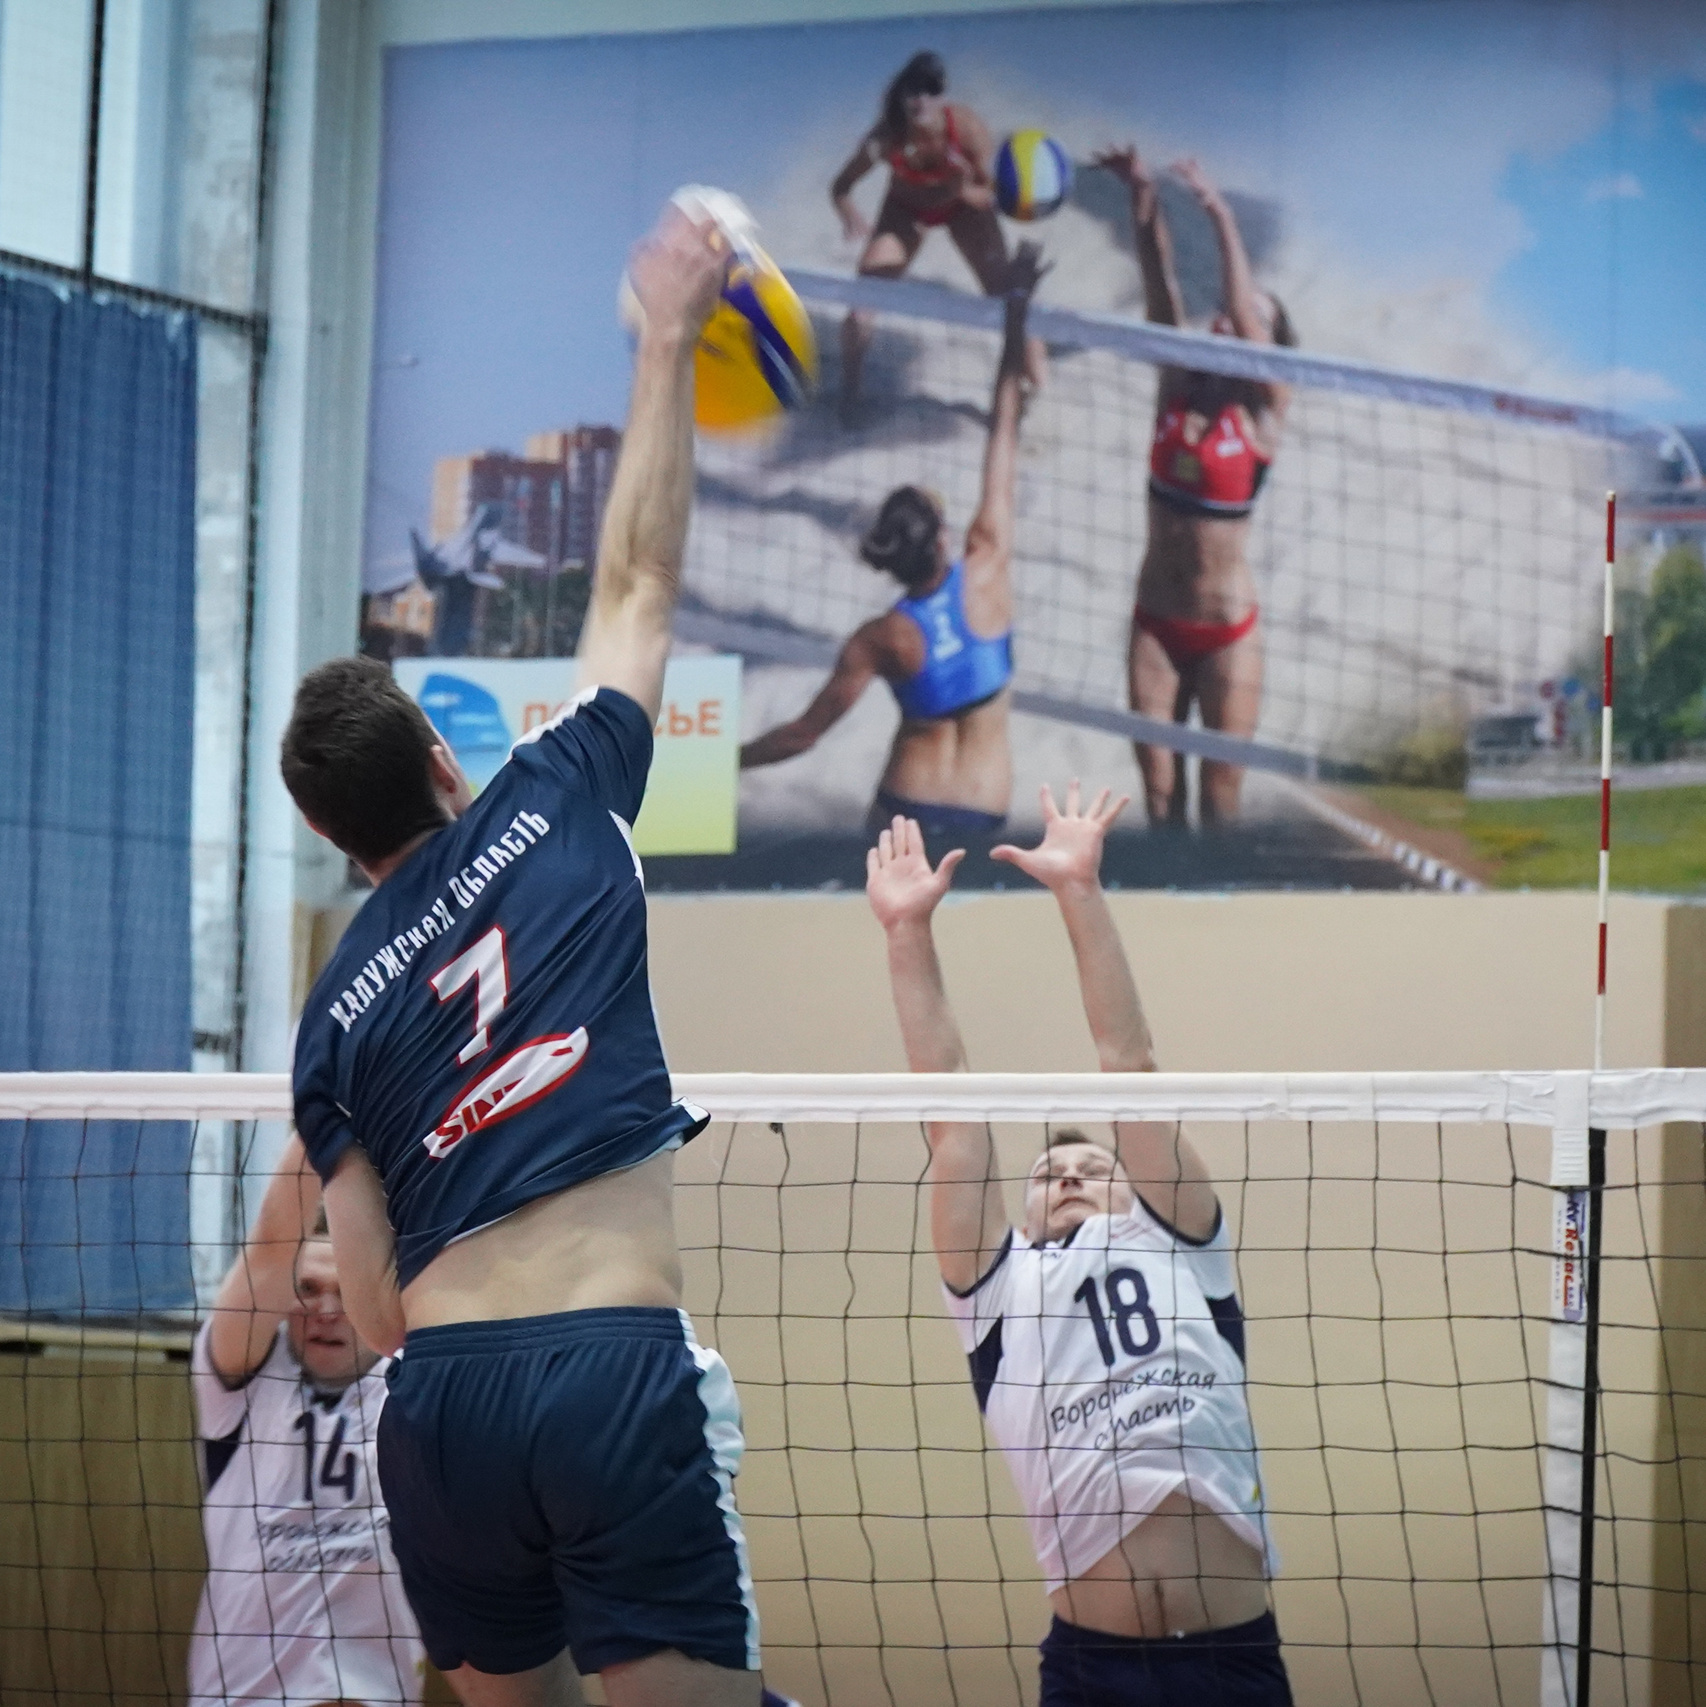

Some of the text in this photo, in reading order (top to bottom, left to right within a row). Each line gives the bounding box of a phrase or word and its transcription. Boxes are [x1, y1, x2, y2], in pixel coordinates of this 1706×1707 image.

[449, 810, 550, 909] ОБЛАСТЬ
[428, 923, 509, 1066] 7
[1073, 1267, 1161, 1367] 18
[293, 1411, 356, 1501] 14
